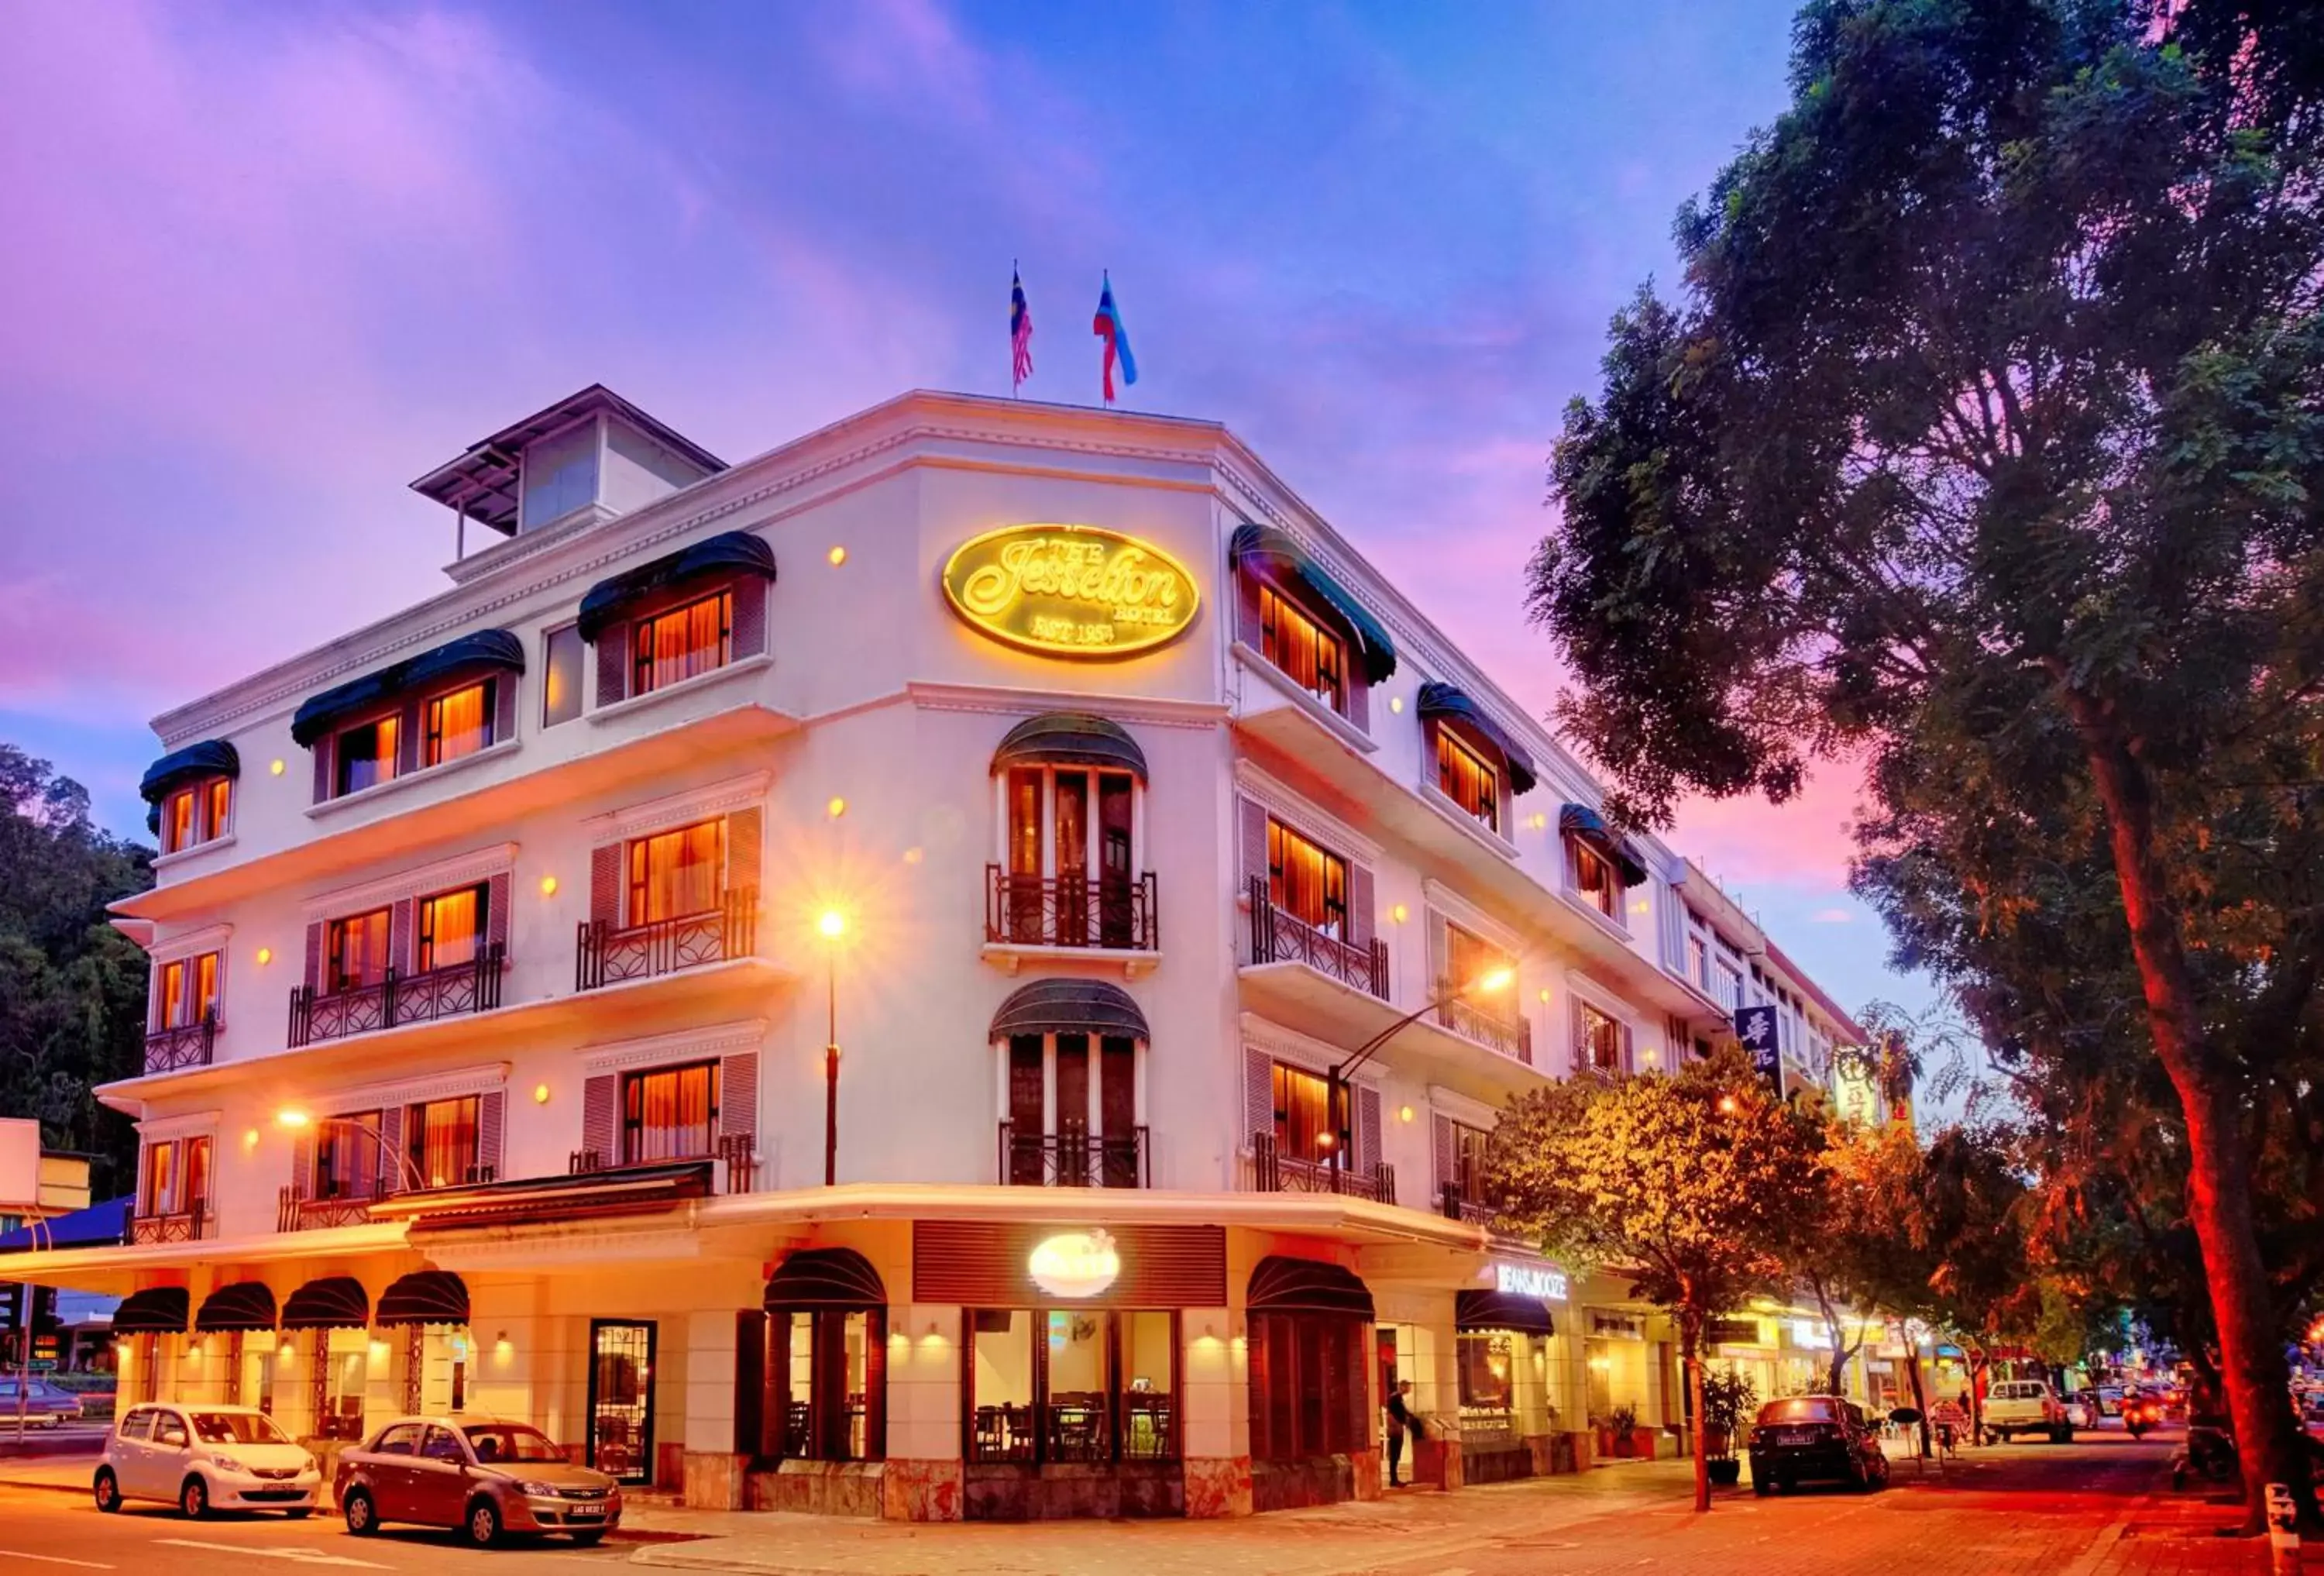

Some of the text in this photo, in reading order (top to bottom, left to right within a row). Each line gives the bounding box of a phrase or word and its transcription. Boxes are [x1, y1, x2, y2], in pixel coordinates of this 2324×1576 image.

[1049, 539, 1104, 564] THE
[963, 539, 1177, 615] Jesselton
[1114, 606, 1174, 624] HOTEL
